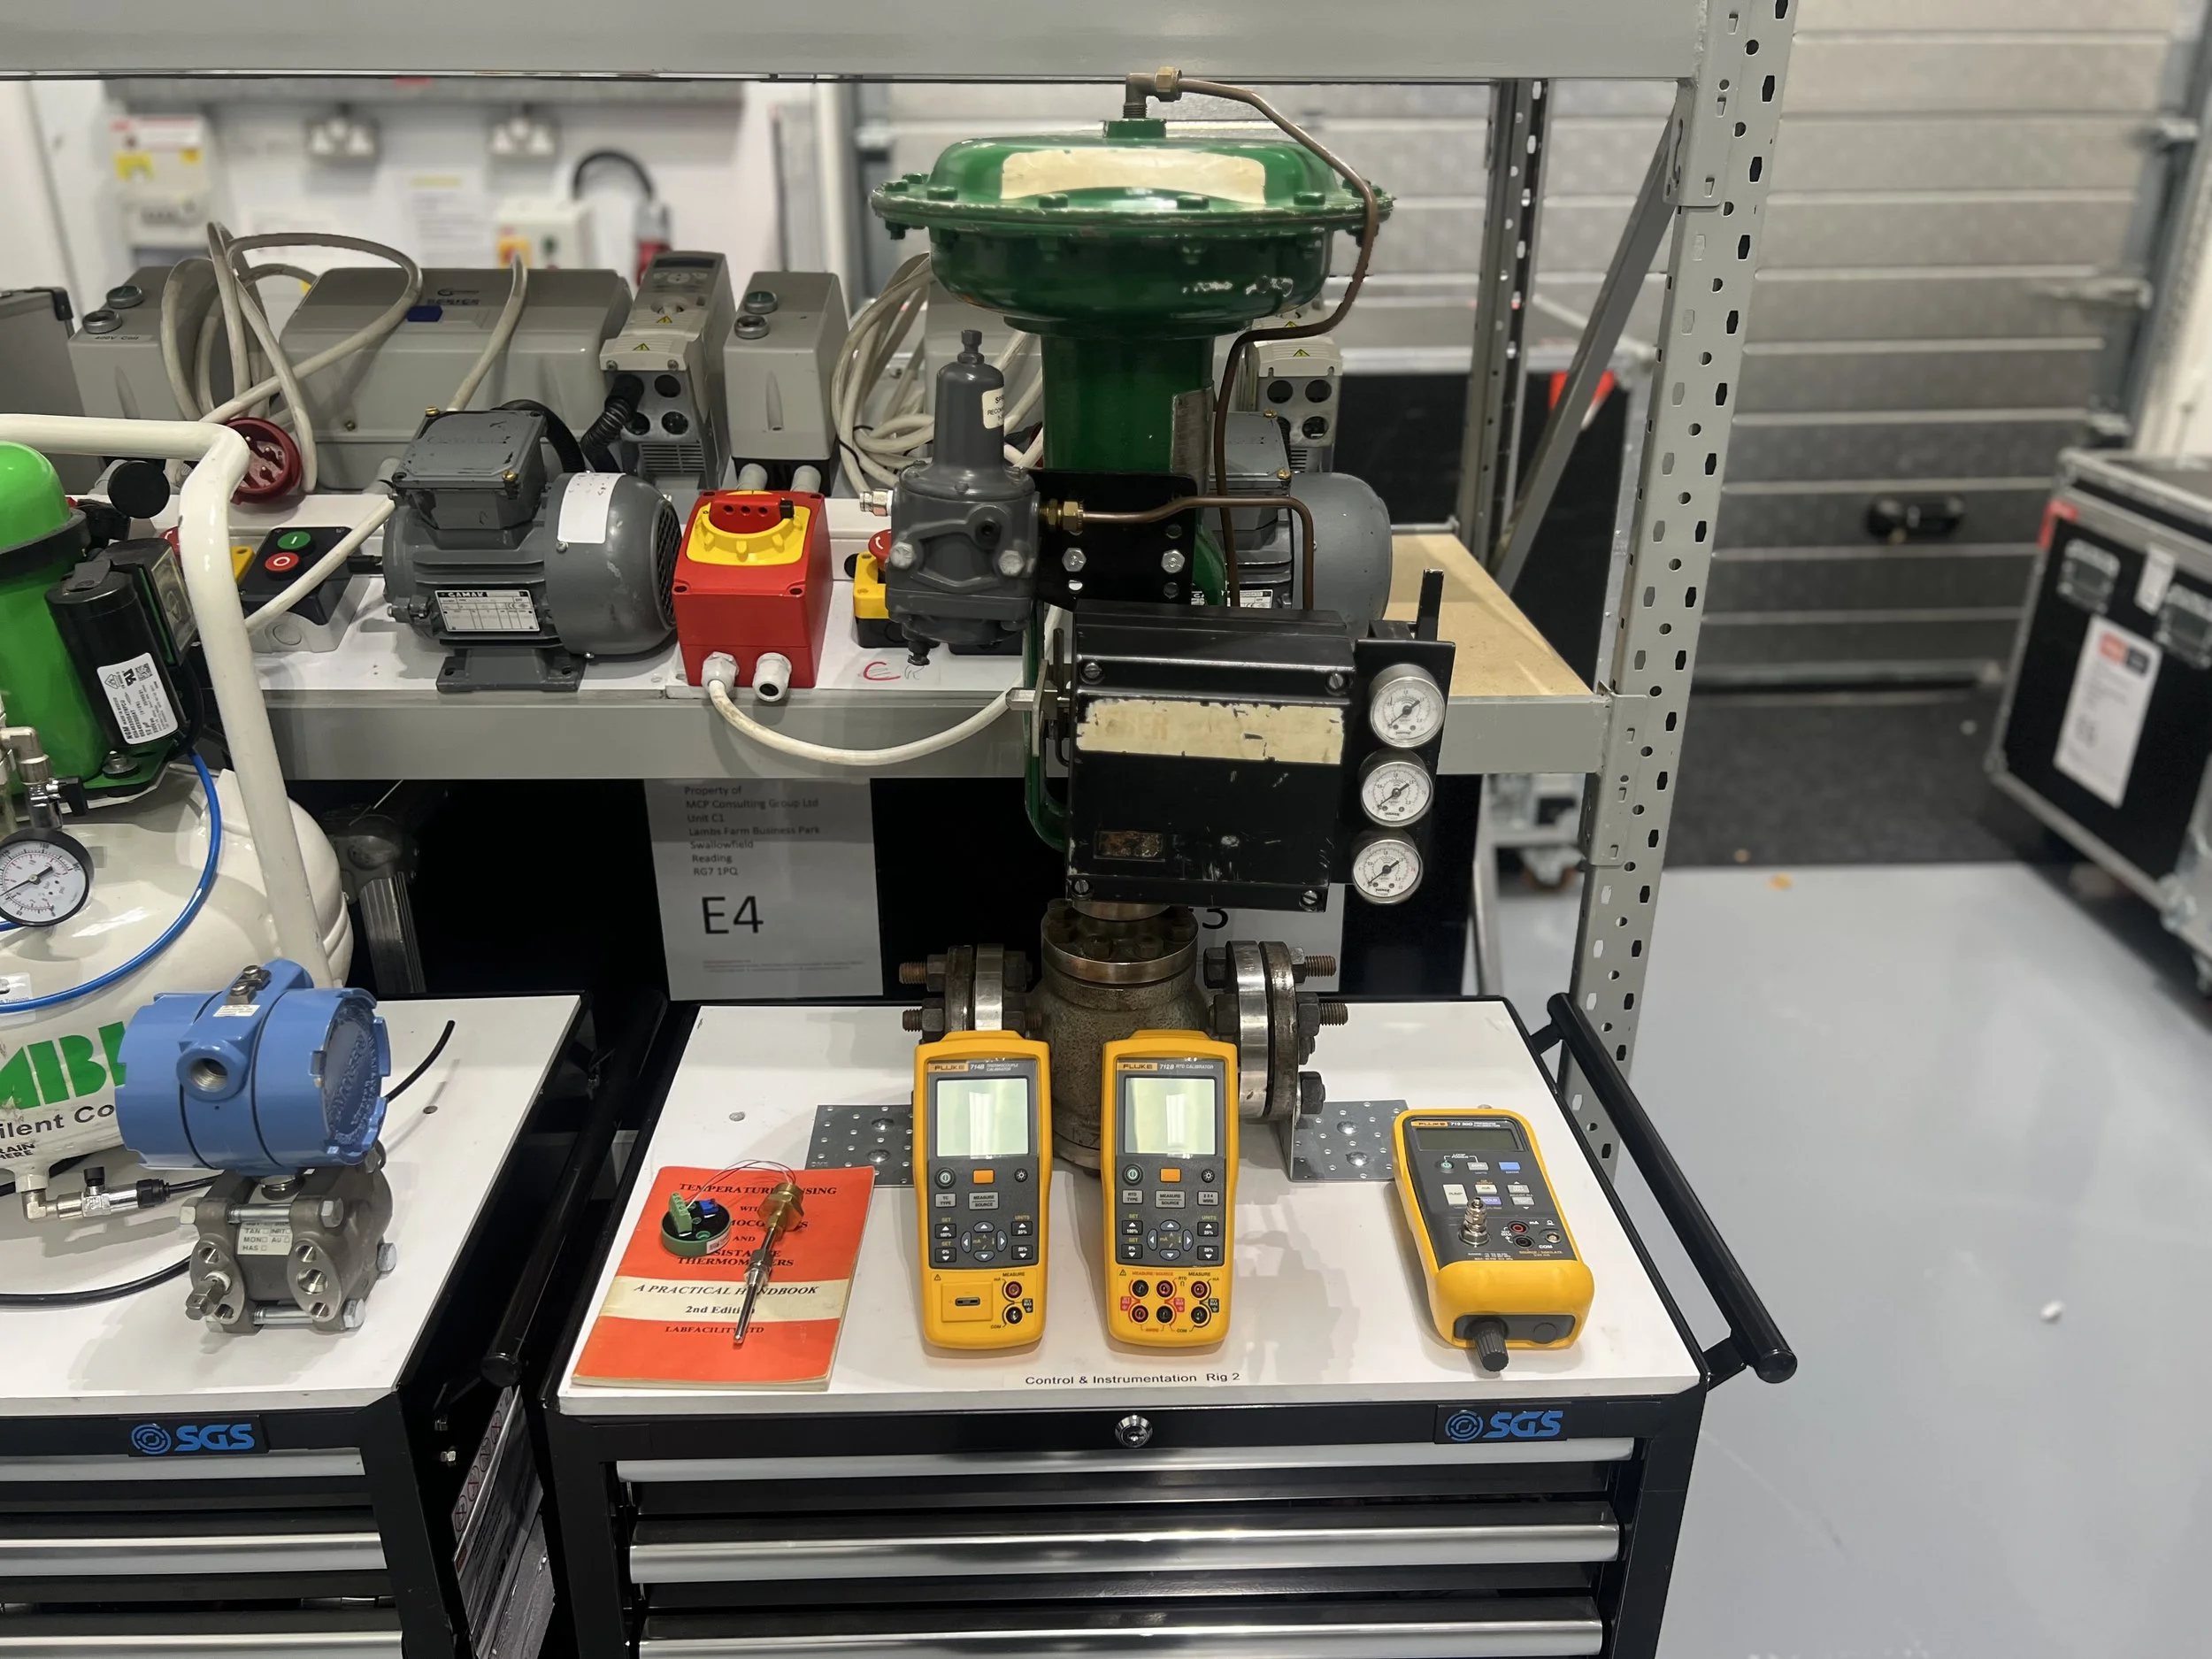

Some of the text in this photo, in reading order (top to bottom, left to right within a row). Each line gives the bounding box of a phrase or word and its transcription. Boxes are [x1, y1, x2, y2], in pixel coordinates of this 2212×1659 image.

[684, 786, 741, 796] Property of
[686, 799, 818, 810] MCP Consulting Group Ltd
[687, 814, 724, 823] Unit C1
[688, 826, 820, 836] Lambs Farm Business Park
[690, 841, 754, 849] Swallowfield
[692, 855, 733, 864] Reading
[718, 867, 739, 877] 1PQ
[702, 895, 764, 934] E4
[680, 1183, 774, 1195] TEMPERATUR
[648, 1286, 733, 1295] PRACTICAL
[737, 1286, 819, 1295] HNDBOOK
[686, 1305, 756, 1315] 2nd Editin
[1025, 1372, 1240, 1385] Control & Instrumentation Rig 2
[1482, 1409, 1563, 1438] SGS
[174, 1423, 255, 1452] SGS
